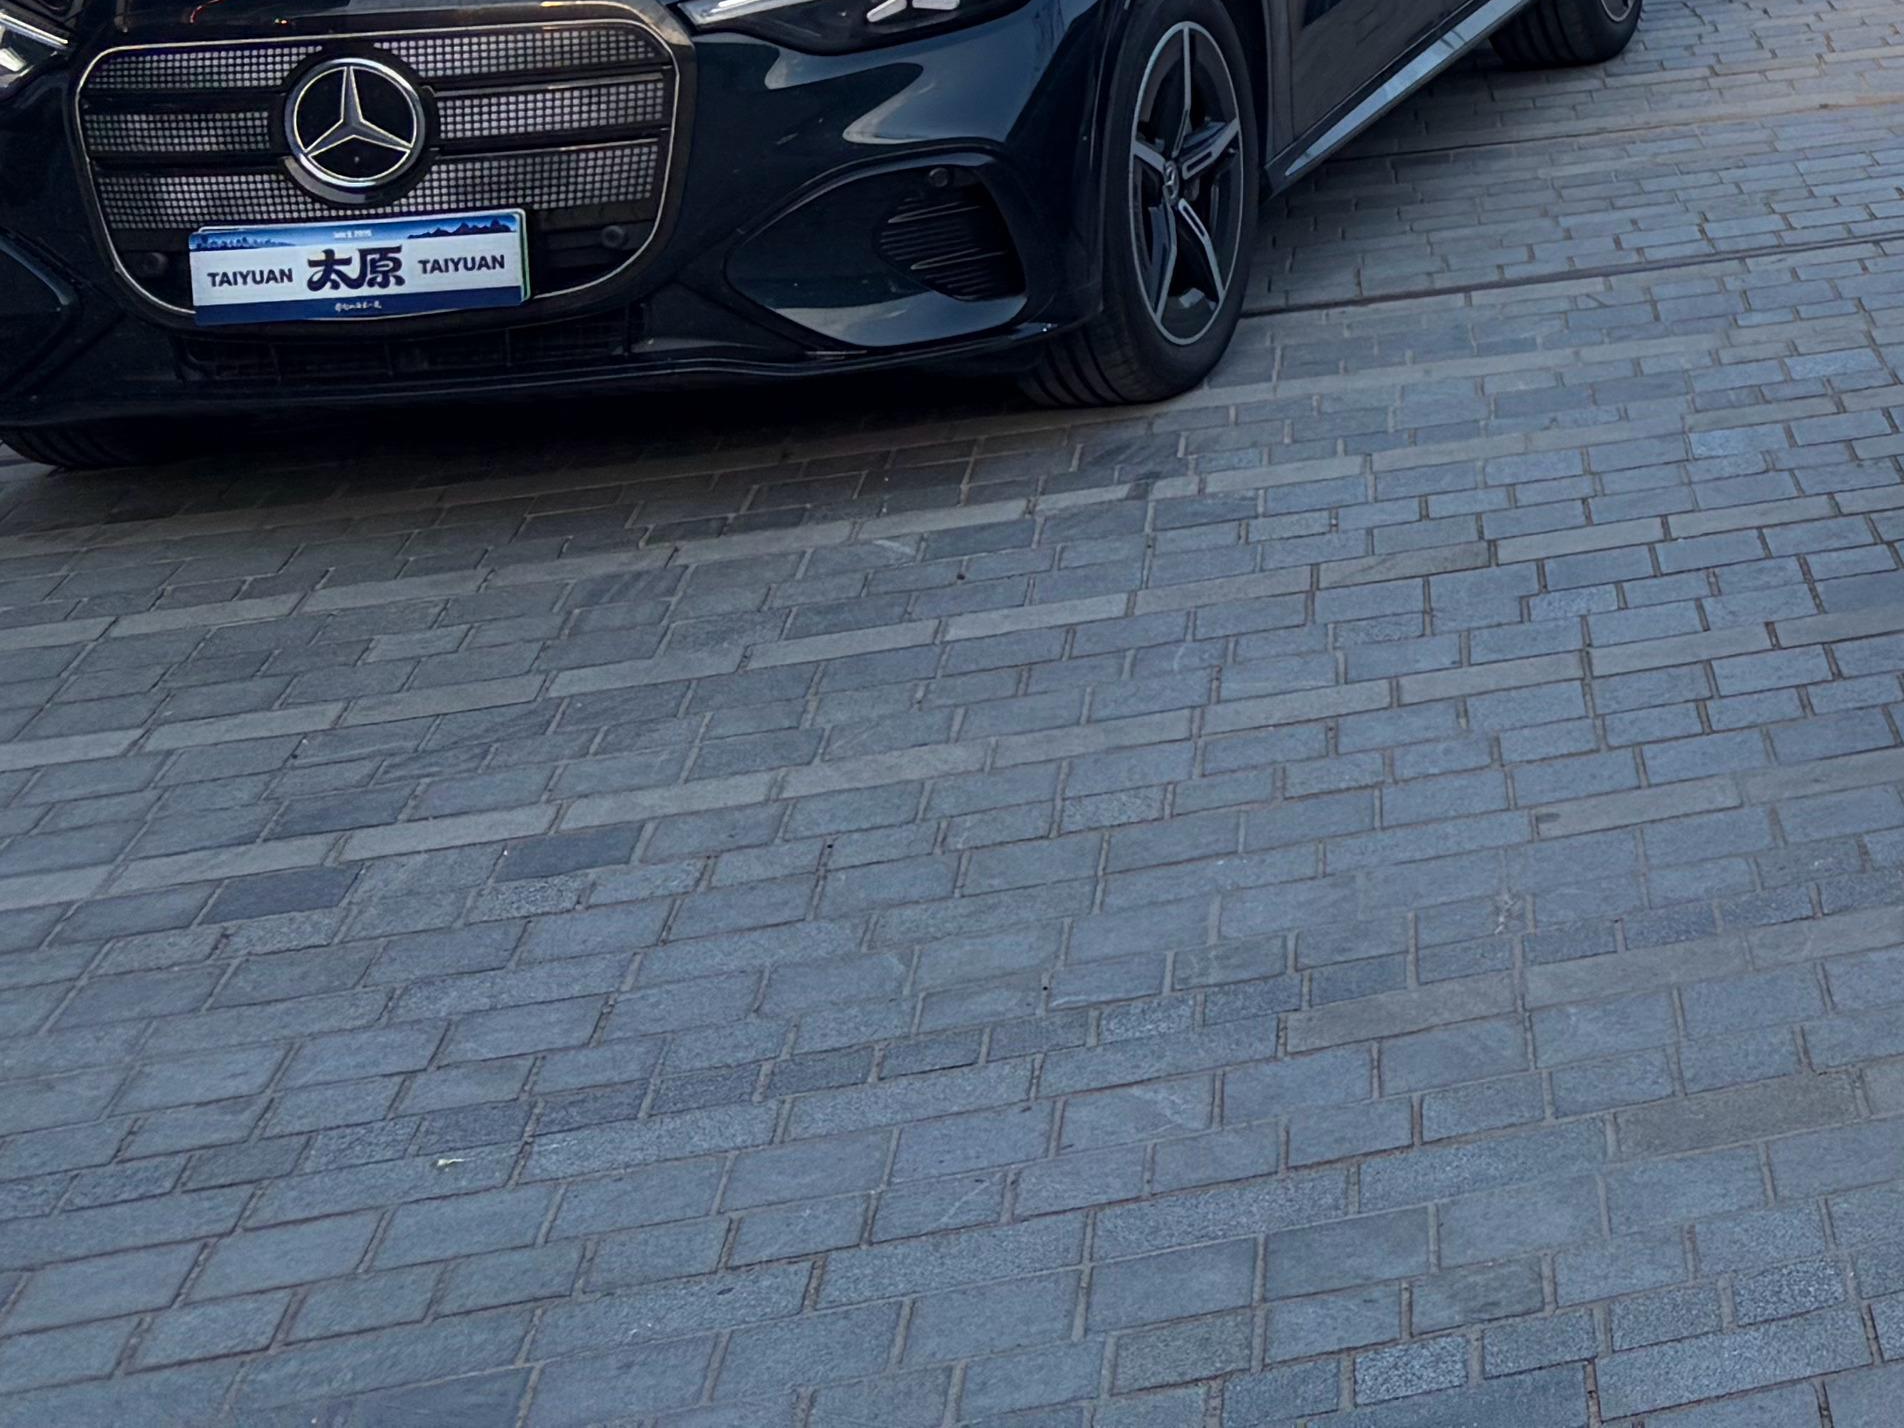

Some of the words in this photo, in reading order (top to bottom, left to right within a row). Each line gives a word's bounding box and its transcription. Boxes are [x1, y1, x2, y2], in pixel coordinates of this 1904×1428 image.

[206, 268, 294, 288] TAIYUAN
[306, 245, 406, 292] 太原
[418, 254, 506, 275] TAIYUAN
